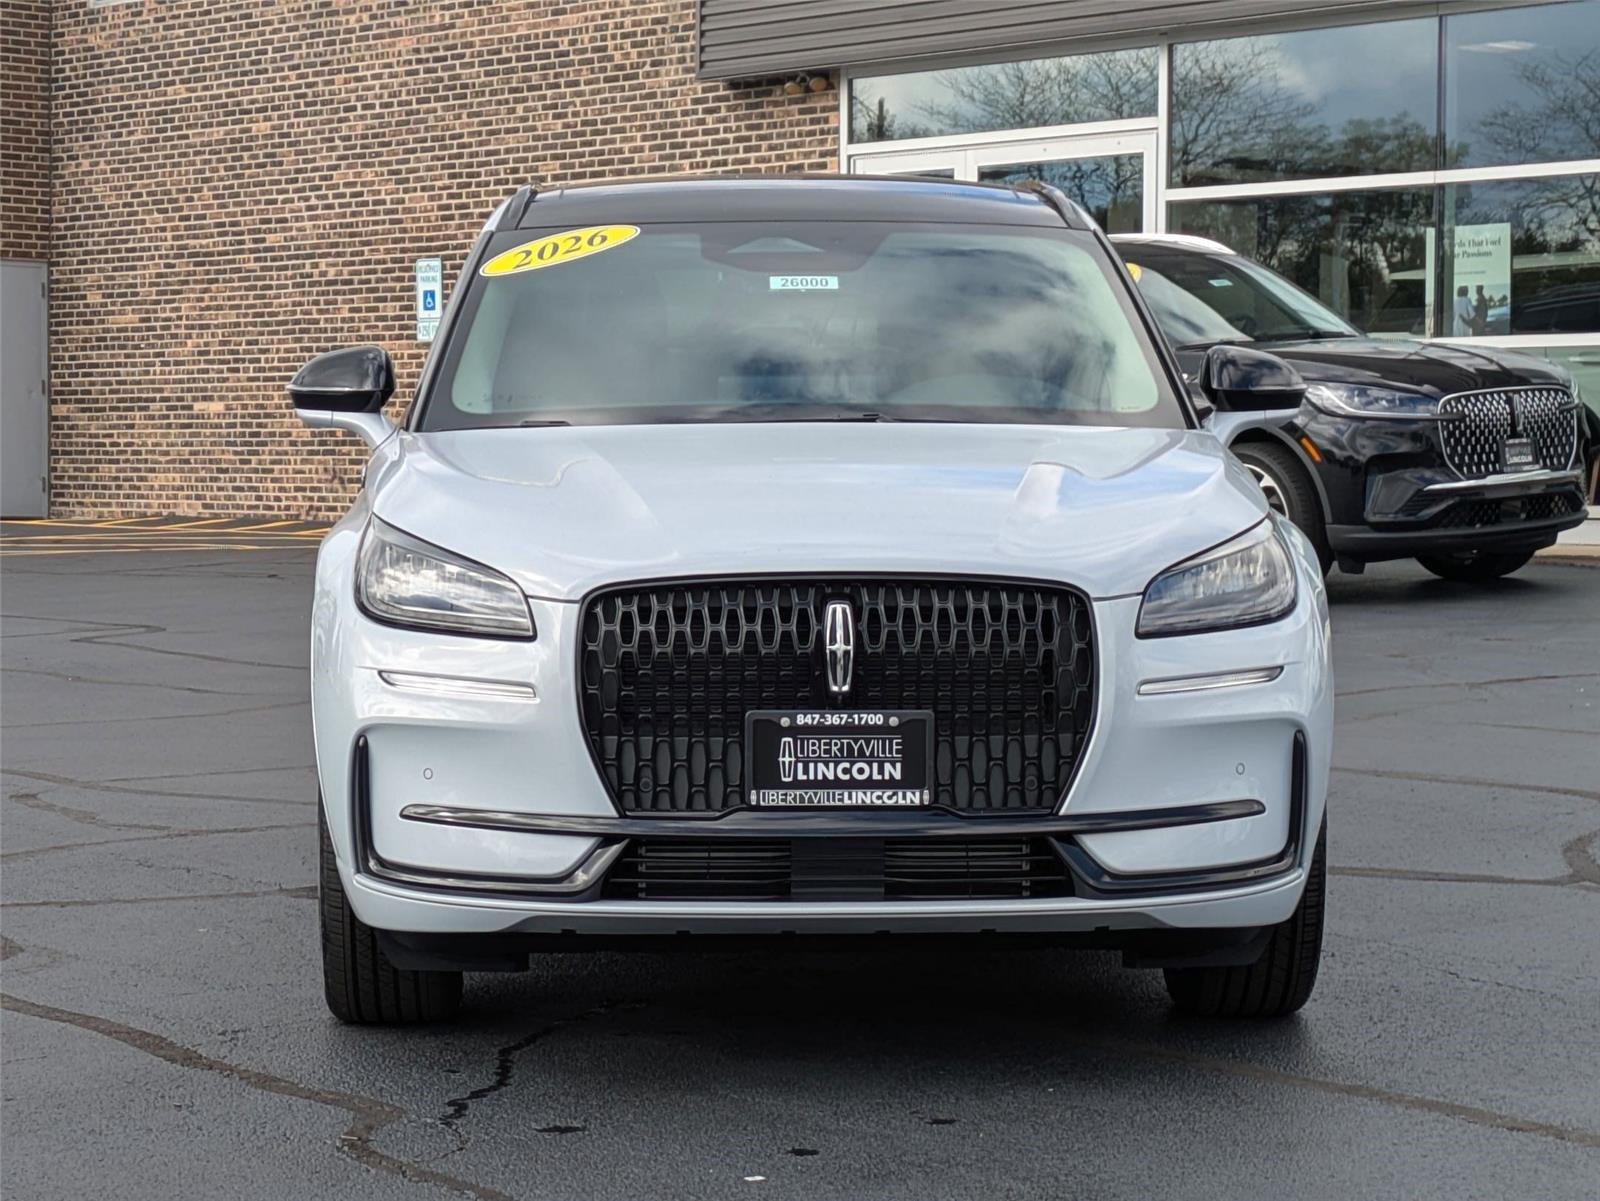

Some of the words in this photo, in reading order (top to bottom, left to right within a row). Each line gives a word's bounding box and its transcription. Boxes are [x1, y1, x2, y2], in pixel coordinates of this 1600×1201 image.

[1468, 238, 1483, 248] That
[512, 229, 608, 269] 2026
[1462, 249, 1493, 259] Passions
[781, 278, 829, 287] 26000
[796, 714, 884, 725] 847-367-1700
[797, 739, 903, 757] LIBERTYVILLE
[797, 762, 902, 780] LINCOLN
